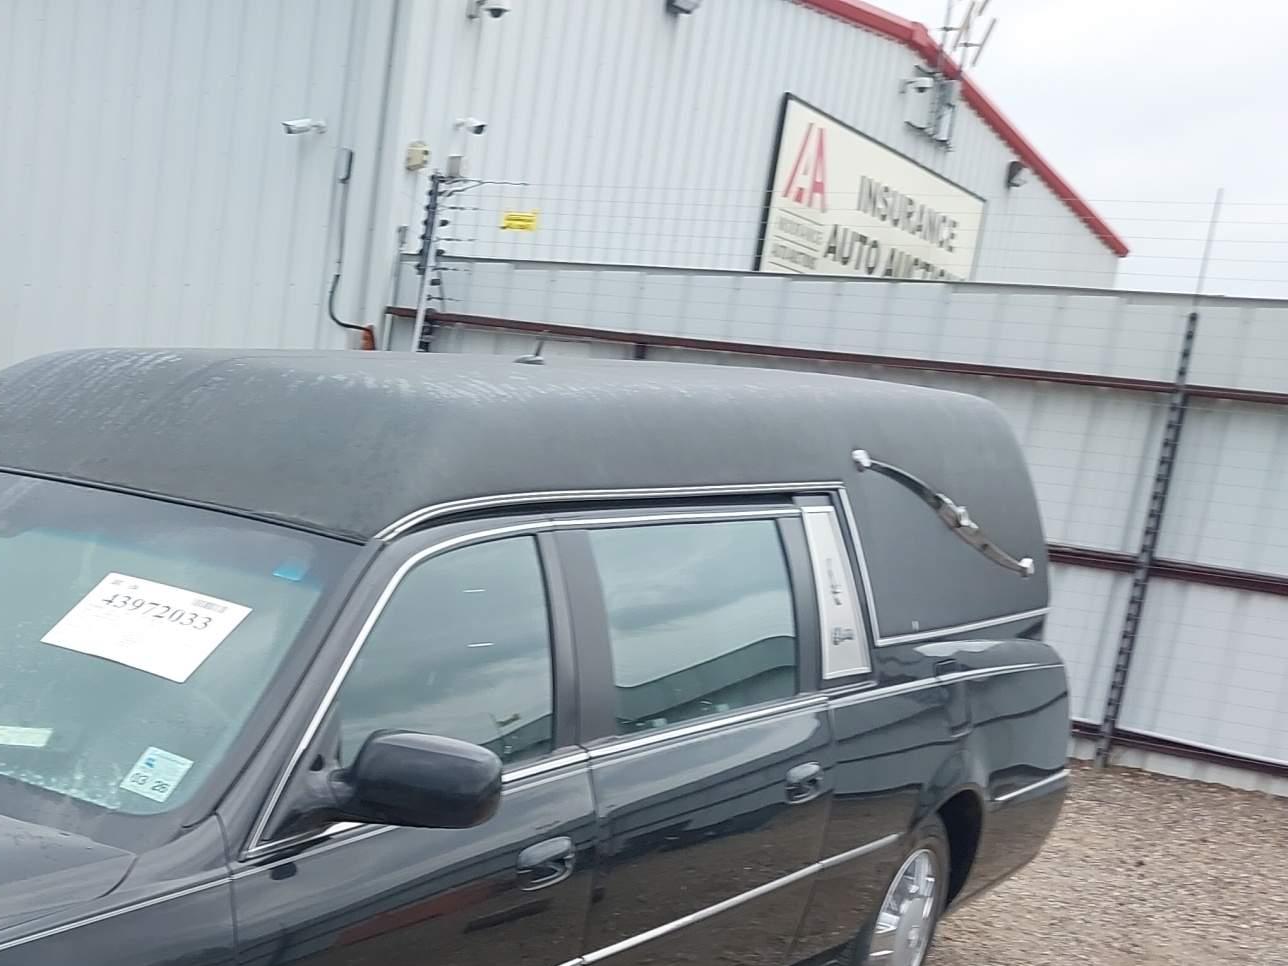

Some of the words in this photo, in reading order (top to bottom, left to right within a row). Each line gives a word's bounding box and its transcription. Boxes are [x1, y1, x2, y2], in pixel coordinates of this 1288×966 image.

[857, 175, 958, 253] INSURANCE
[824, 223, 879, 275] AUTO
[102, 593, 213, 631] 43972033
